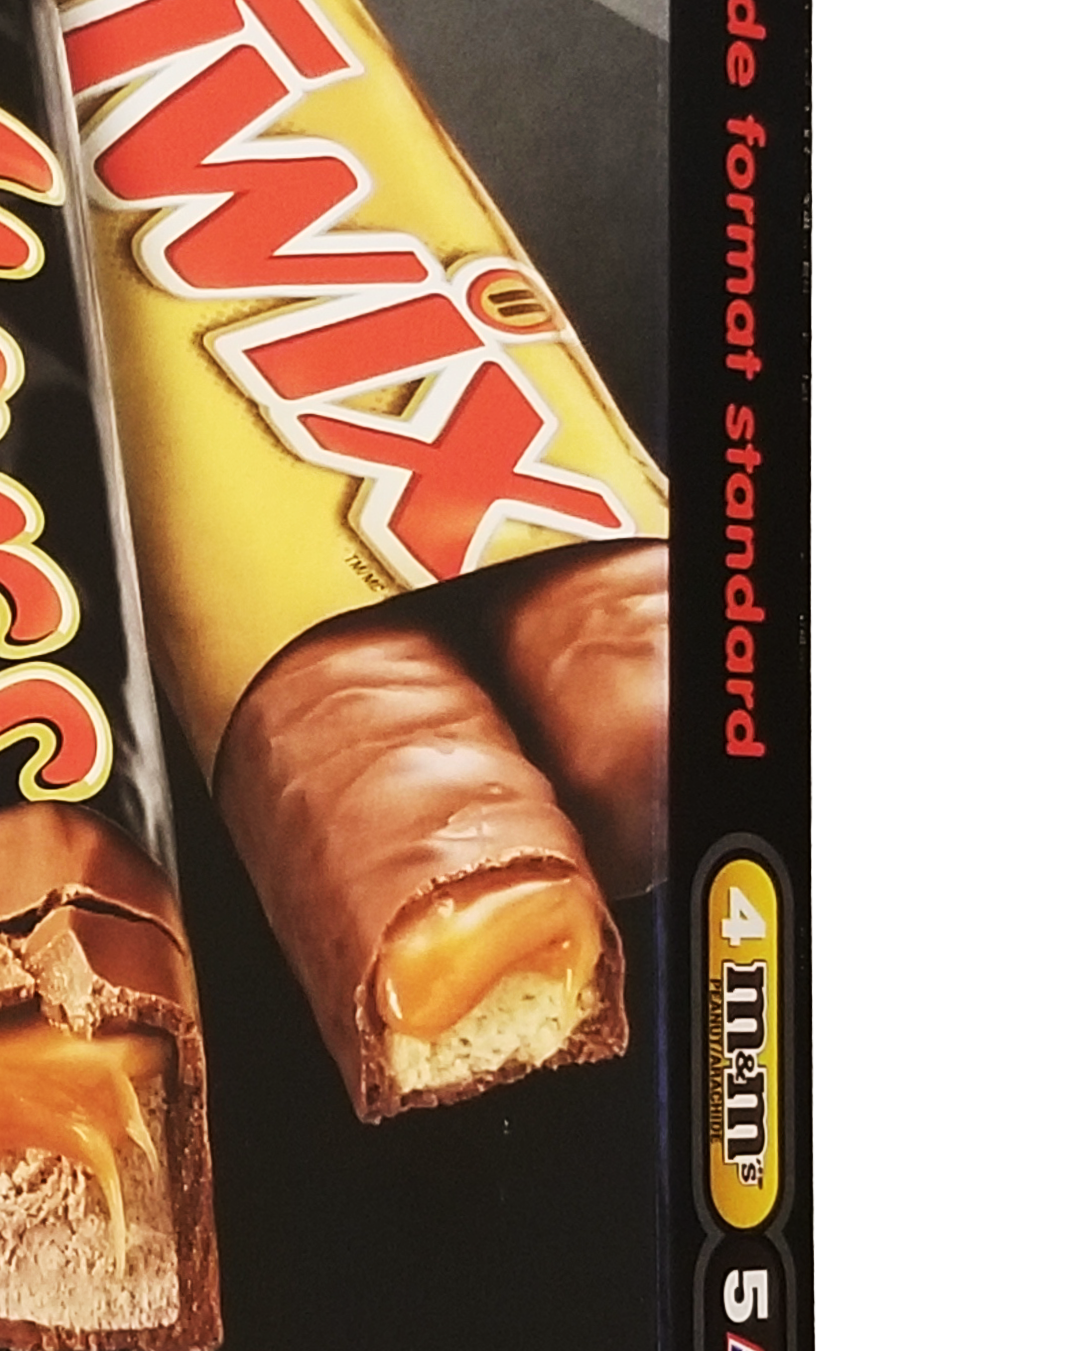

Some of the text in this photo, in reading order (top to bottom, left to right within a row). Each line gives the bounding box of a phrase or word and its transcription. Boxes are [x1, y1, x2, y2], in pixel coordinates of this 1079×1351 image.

[726, 114, 767, 380] format
[725, 403, 766, 758] standard
[721, 886, 766, 947] 4
[709, 978, 722, 1144] PEANUT/ARACHIDE
[723, 1269, 768, 1324] 5
